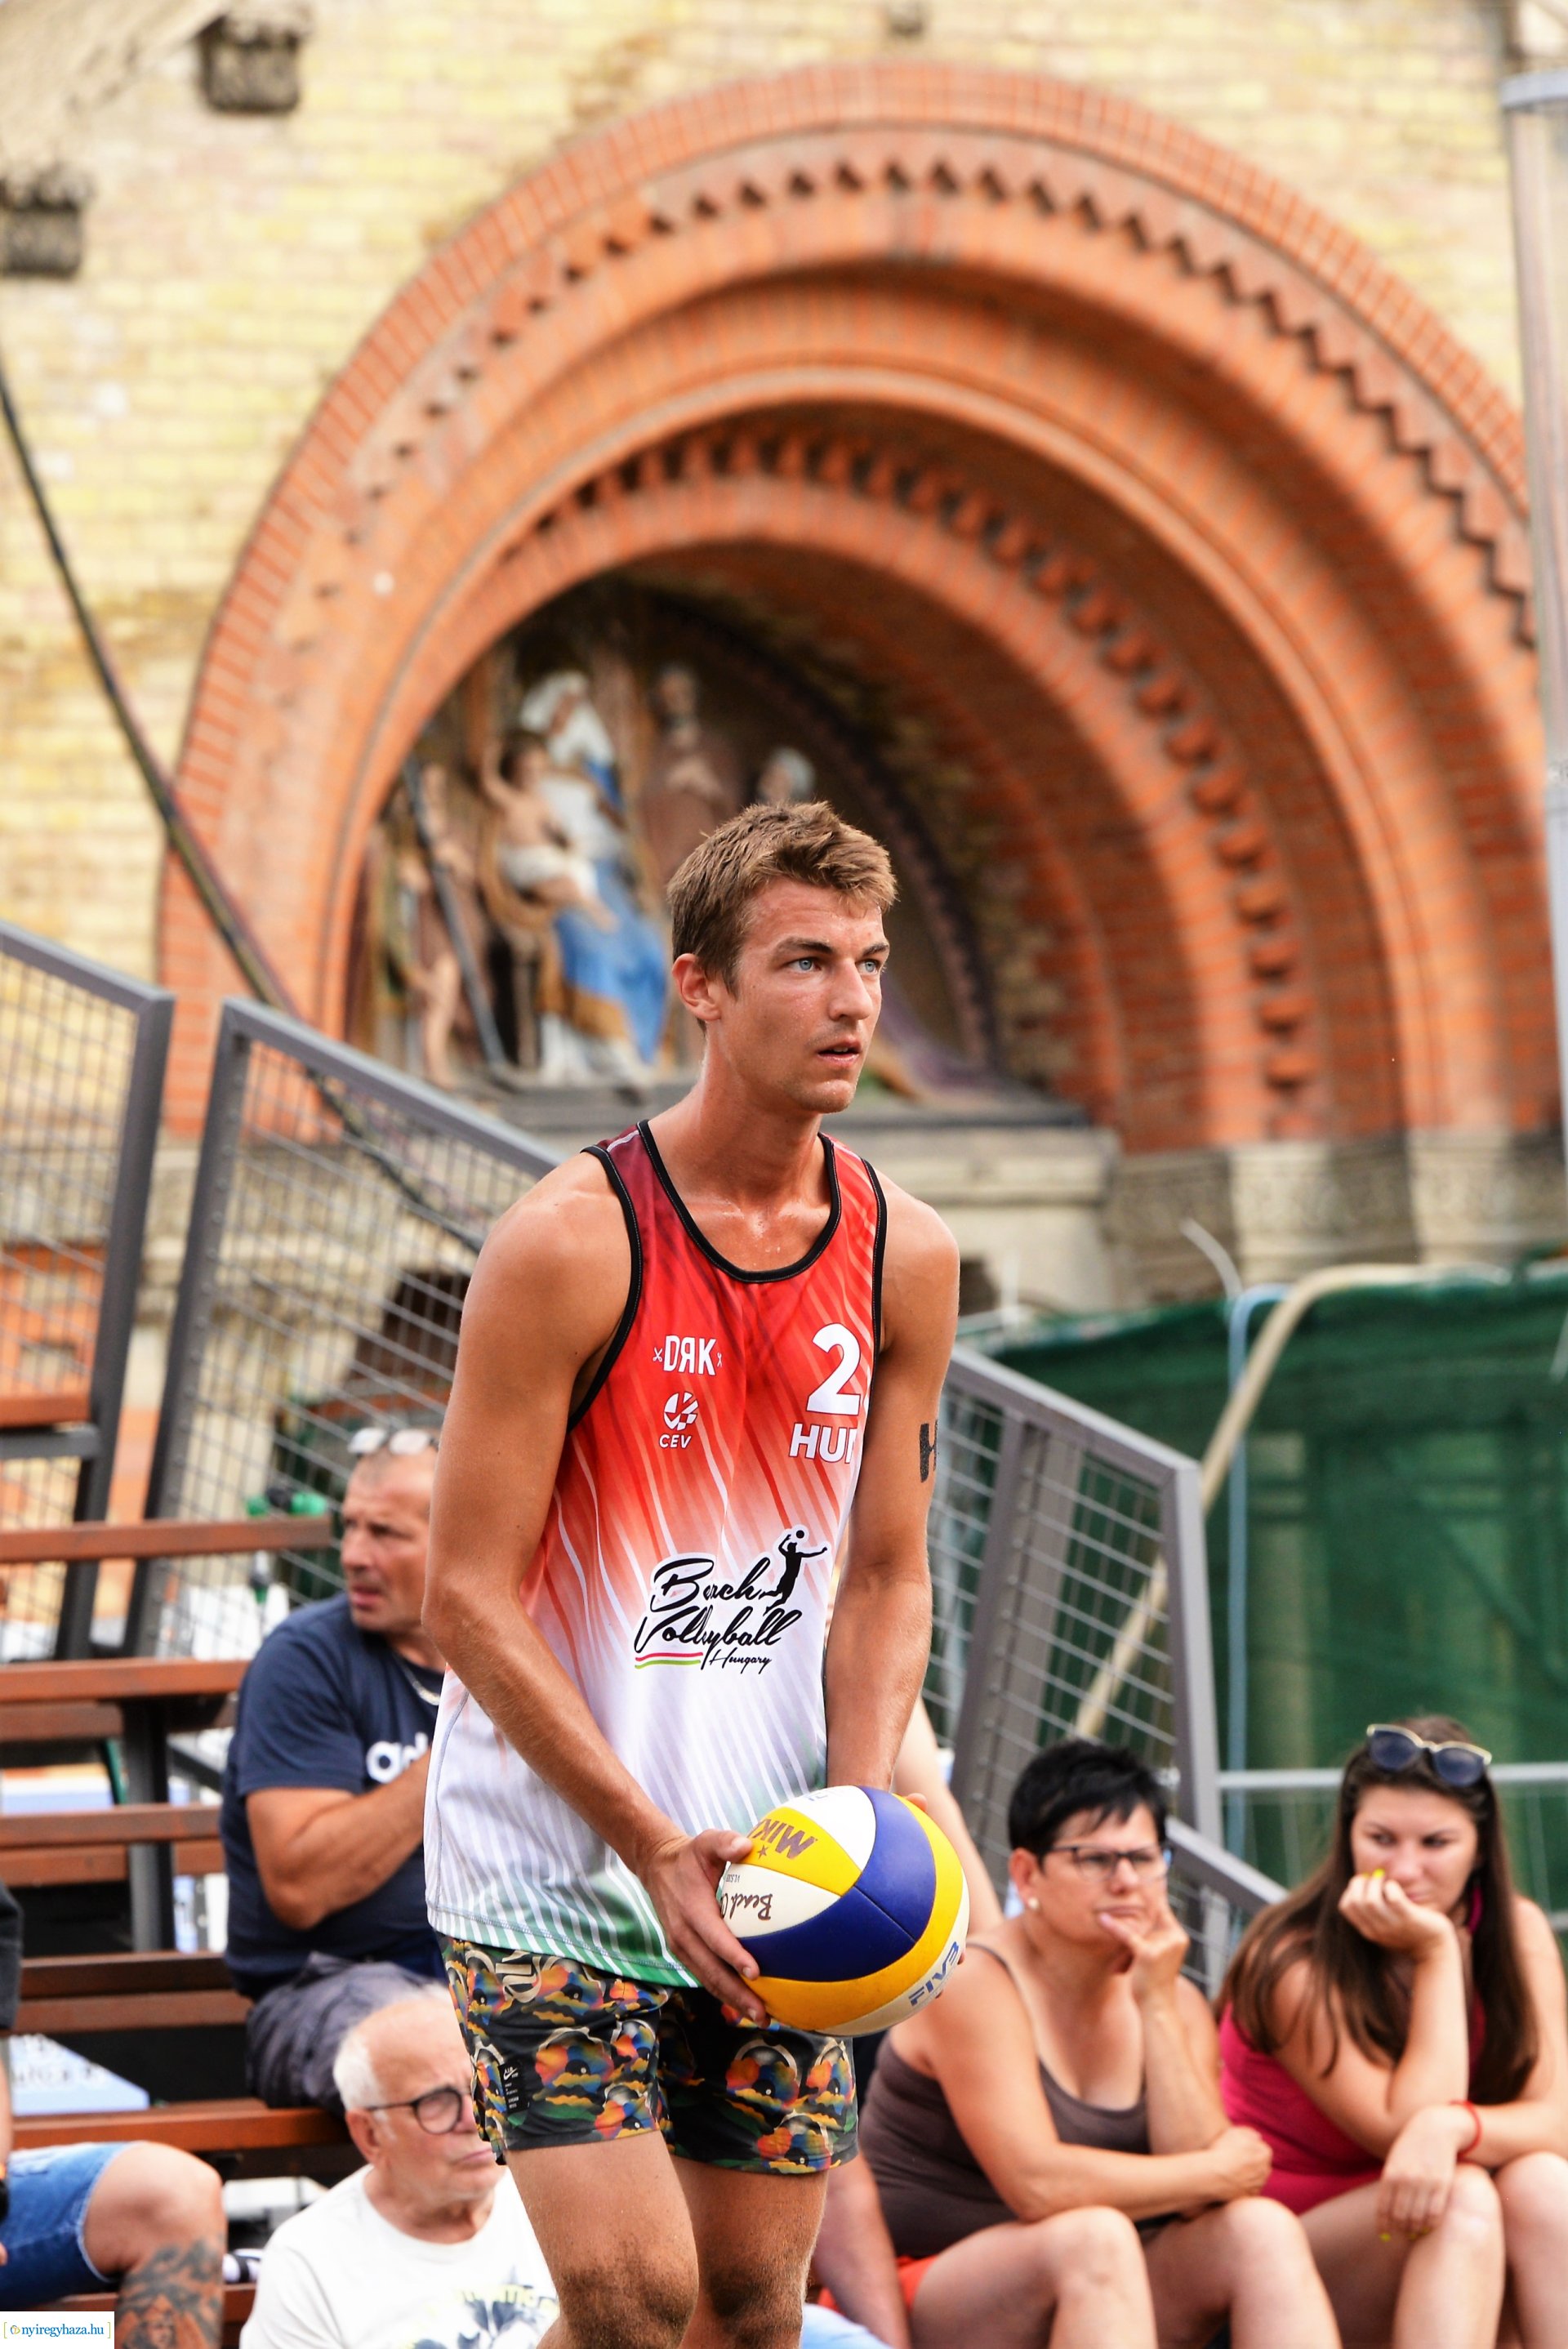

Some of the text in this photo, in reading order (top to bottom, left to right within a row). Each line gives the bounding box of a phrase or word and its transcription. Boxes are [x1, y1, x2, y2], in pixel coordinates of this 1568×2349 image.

[806, 1322, 862, 1416] 2
[658, 1433, 693, 1450] CEV
[709, 1647, 773, 1674] Hungary
[746, 1818, 816, 1860] MIK
